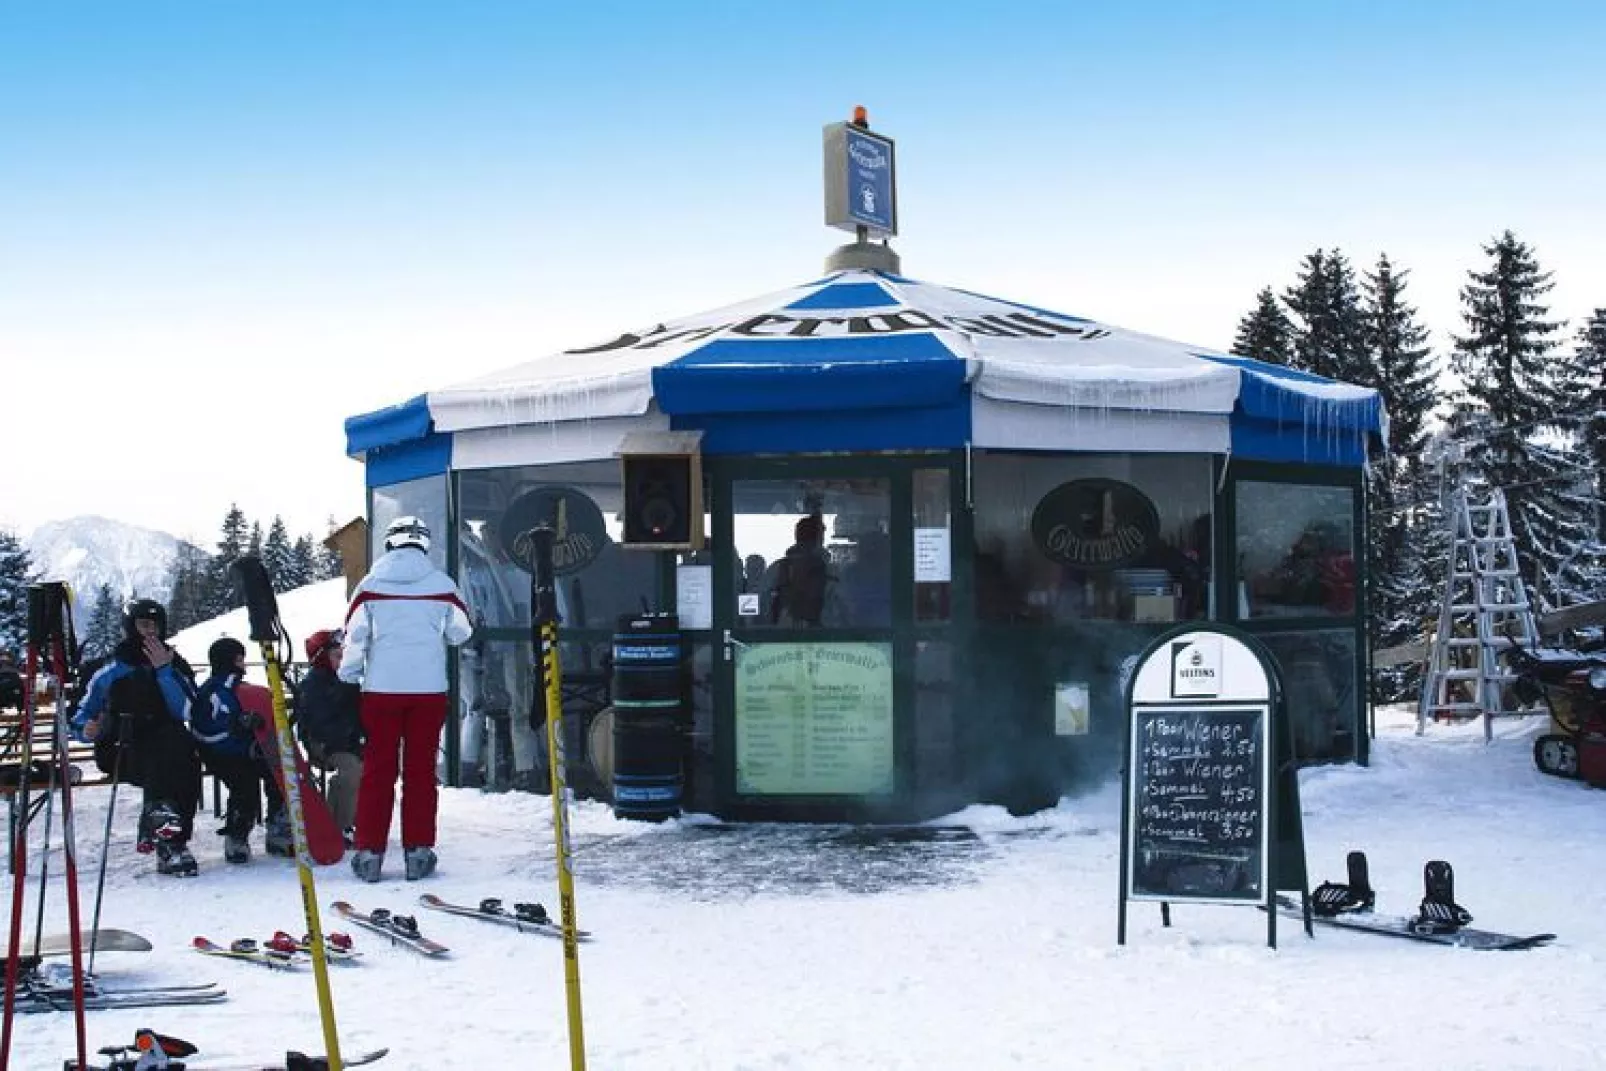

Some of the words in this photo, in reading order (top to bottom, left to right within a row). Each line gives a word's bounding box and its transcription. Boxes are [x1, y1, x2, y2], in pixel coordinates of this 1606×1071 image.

[1179, 667, 1216, 678] VELTINS
[1184, 715, 1243, 742] Wiener
[1181, 758, 1245, 779] Wiener
